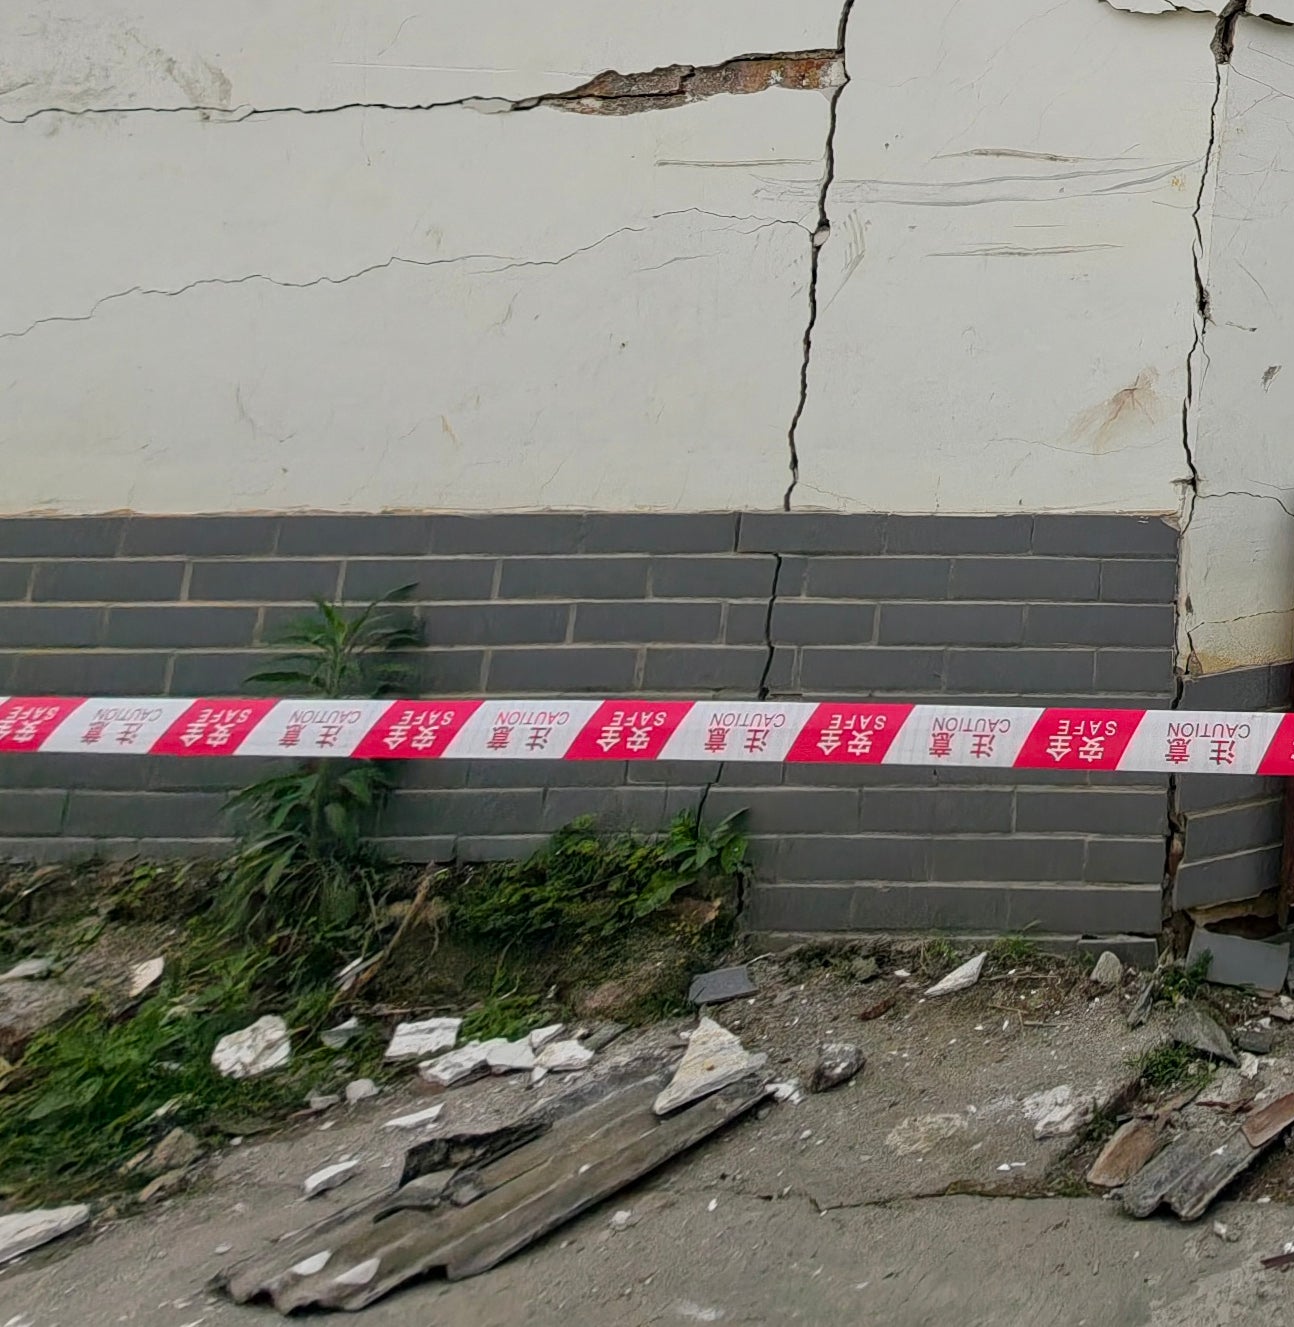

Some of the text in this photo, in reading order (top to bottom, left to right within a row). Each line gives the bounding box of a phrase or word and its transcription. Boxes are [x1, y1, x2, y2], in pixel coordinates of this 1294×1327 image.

[6, 706, 60, 721] SAFE
[92, 707, 164, 722] CAUTION
[198, 708, 252, 723] SAFE
[288, 710, 361, 724] CAUTION
[402, 710, 455, 724] SAFE
[496, 711, 570, 725] CAUTION
[611, 710, 667, 726] SAFE
[709, 712, 785, 727] CAUTION
[829, 714, 887, 729] SAFE
[81, 722, 141, 745] 注意
[179, 720, 230, 747] 安全
[932, 716, 1011, 733] CAUTION
[1059, 719, 1116, 736] SAFE
[1167, 721, 1250, 739] CAUTION
[279, 725, 344, 748] 注意
[383, 722, 435, 751] 安全
[488, 727, 552, 751] 注意
[596, 724, 651, 752] 安全
[705, 728, 769, 753] 注意
[816, 728, 871, 756] 安全
[929, 732, 995, 759] 注意
[1046, 734, 1104, 762] 安全
[1166, 737, 1237, 765] 注意
